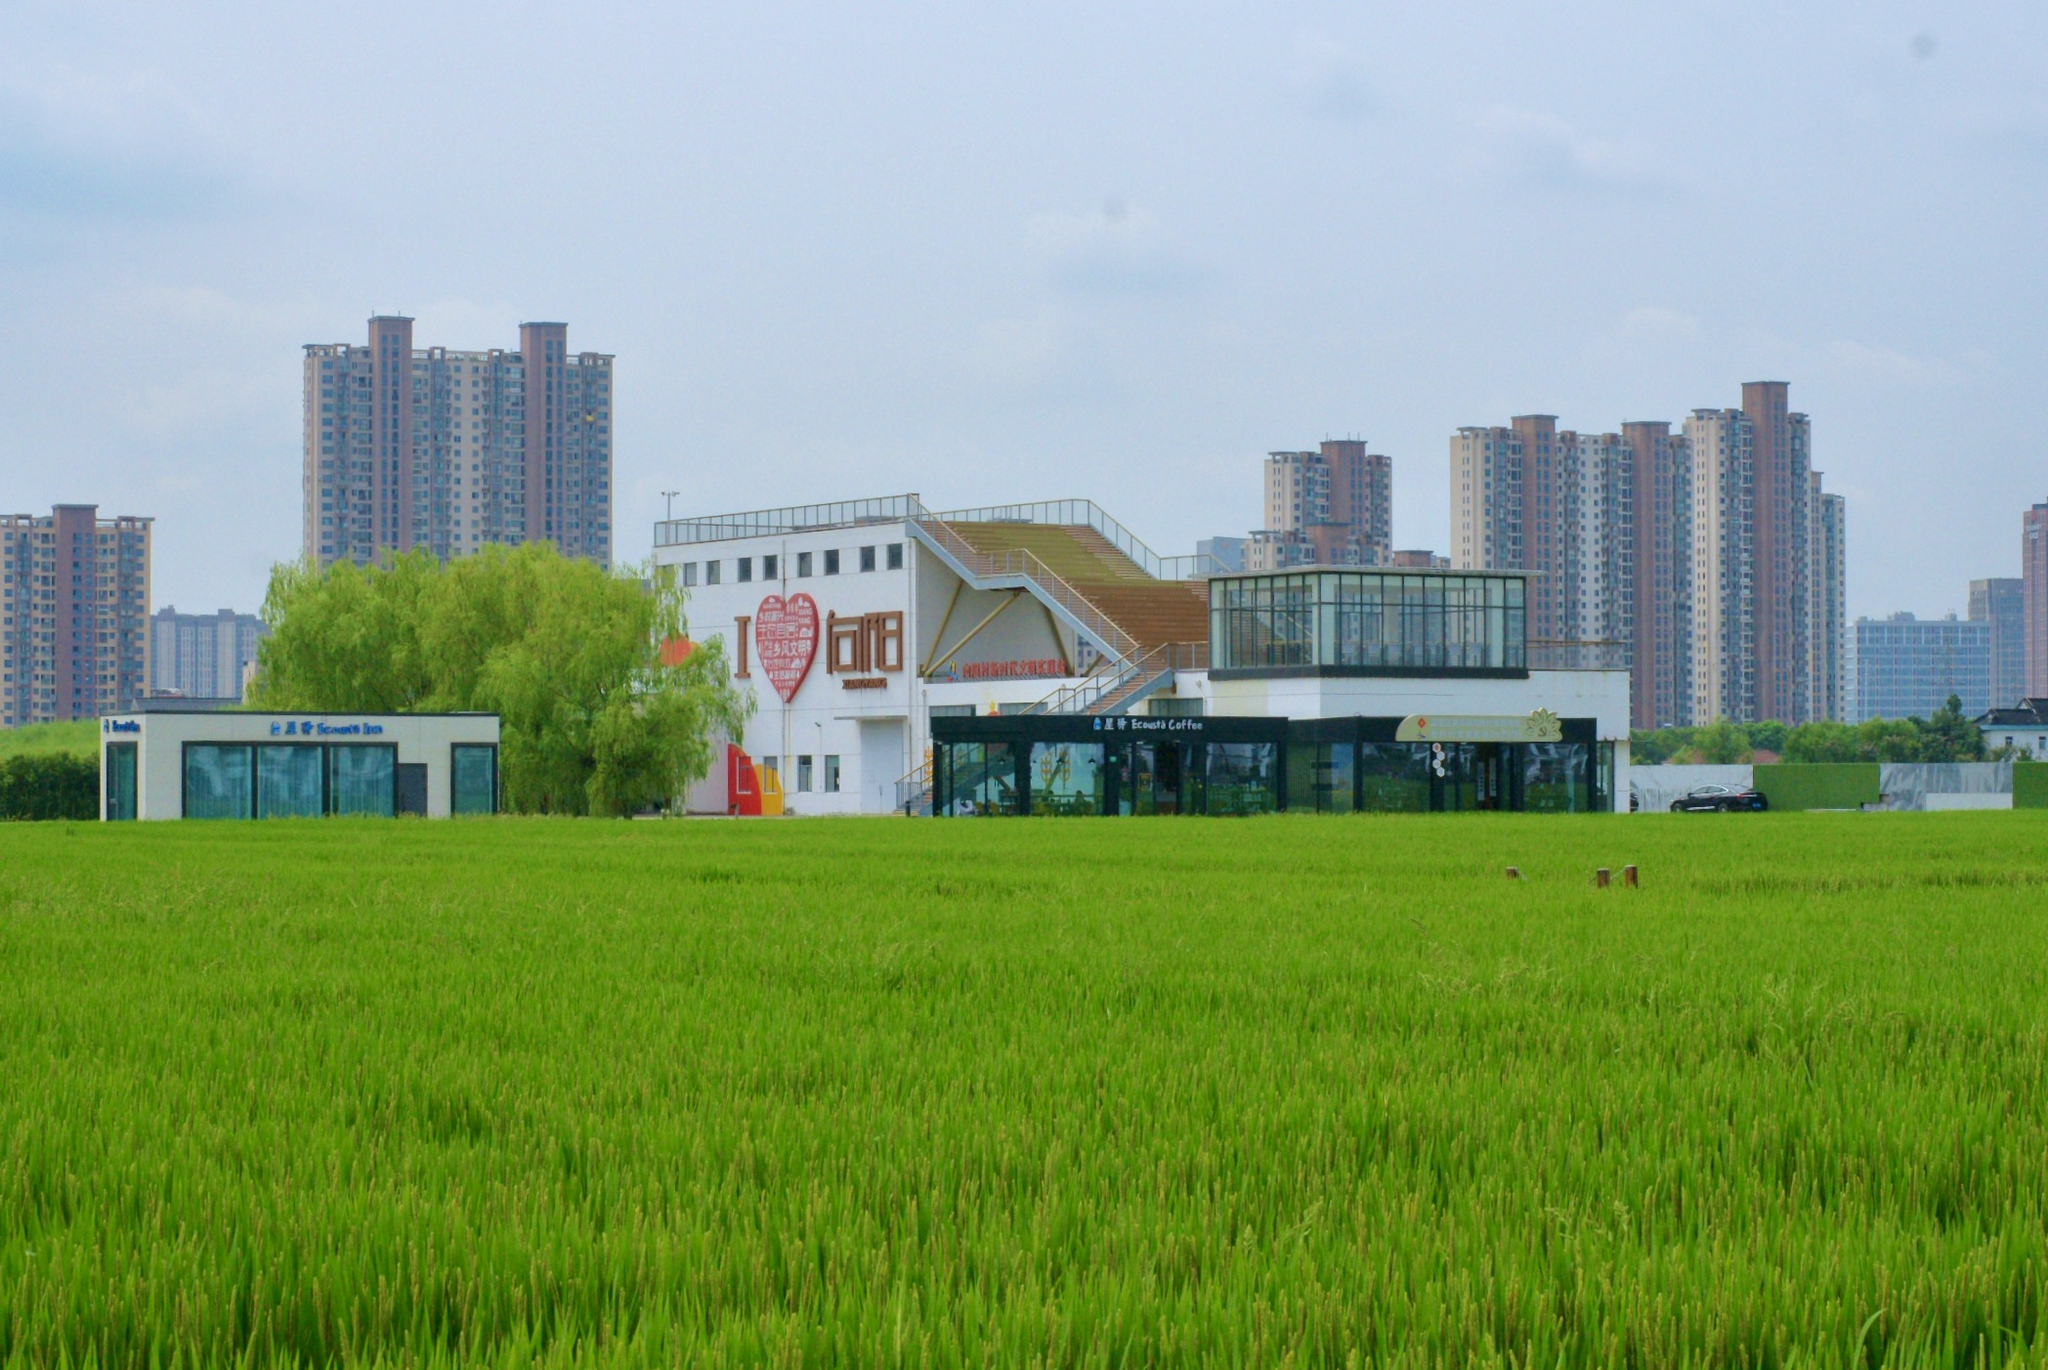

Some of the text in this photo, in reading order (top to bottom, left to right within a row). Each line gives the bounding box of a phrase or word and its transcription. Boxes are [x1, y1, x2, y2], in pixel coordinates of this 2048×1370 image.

[734, 616, 751, 679] I
[773, 639, 806, 657] 乡风文明
[826, 610, 903, 675] 向阳
[842, 677, 887, 690] XIANGYANG
[363, 722, 383, 735] Inn
[1168, 719, 1203, 730] Coffee
